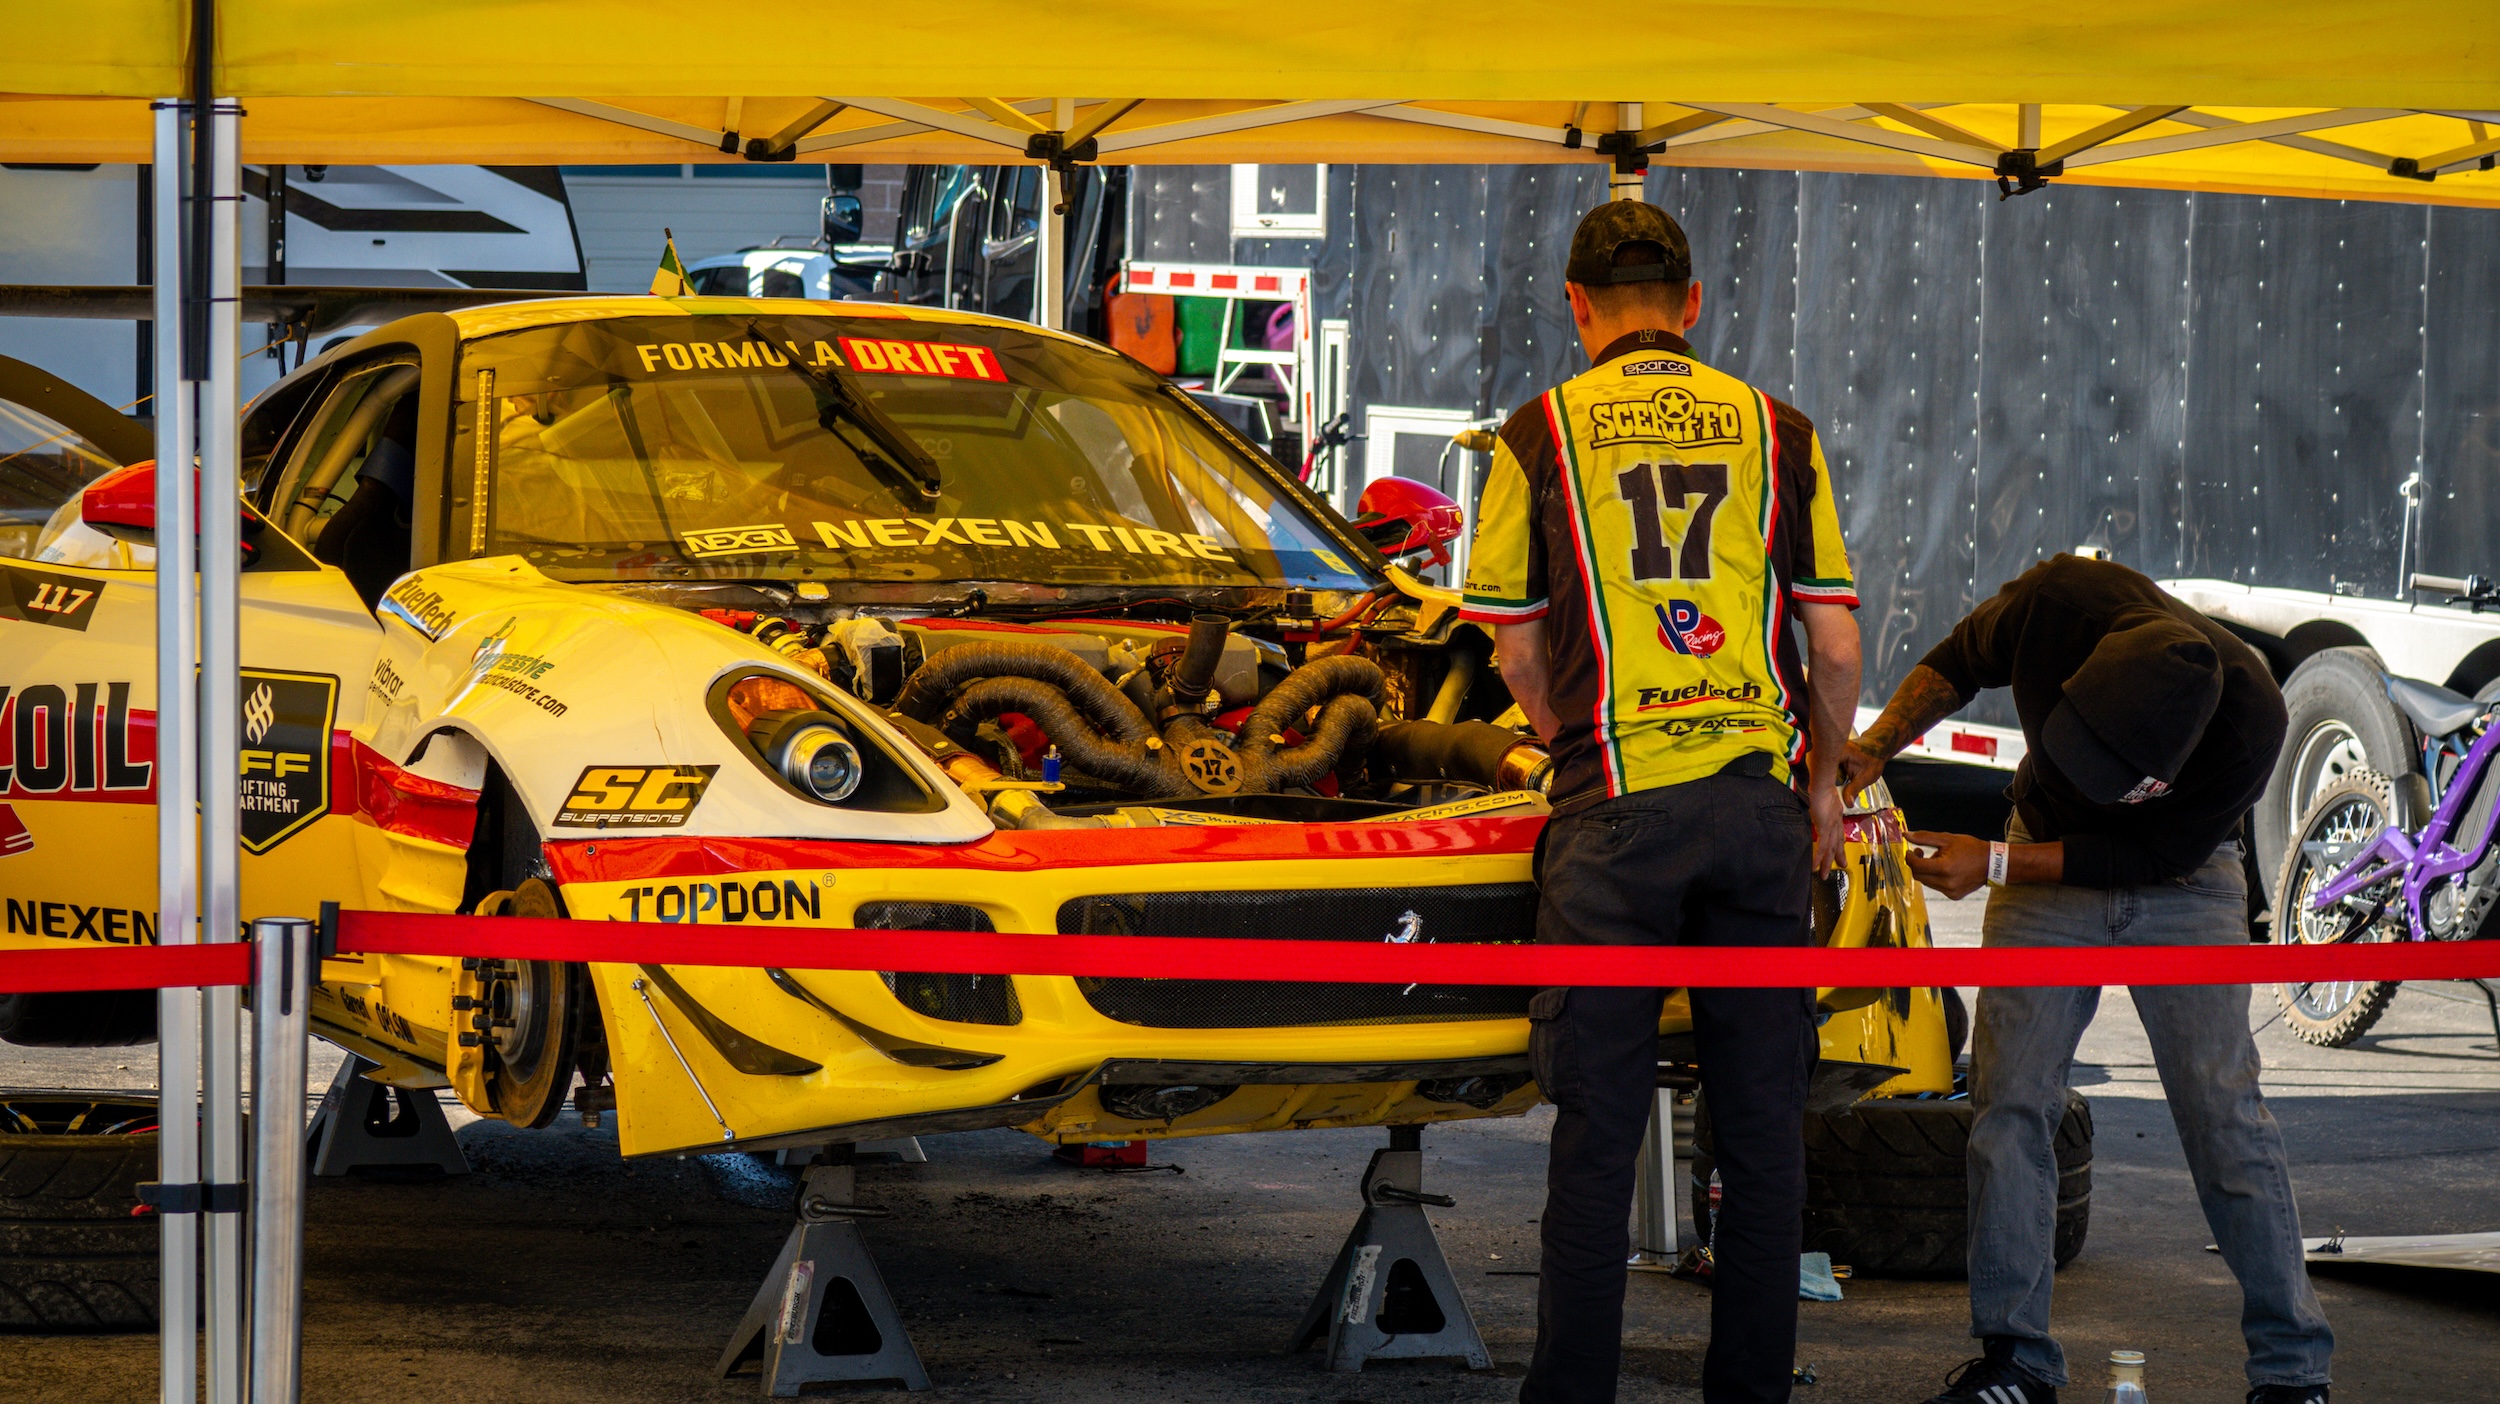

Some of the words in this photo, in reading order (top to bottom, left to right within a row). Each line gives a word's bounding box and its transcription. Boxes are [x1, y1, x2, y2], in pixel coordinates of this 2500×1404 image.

[850, 338, 990, 378] DRIFT
[1624, 361, 1690, 375] sparco
[1618, 463, 1728, 580] 17
[683, 527, 797, 553] NEXEN
[812, 517, 1061, 550] NEXEN
[1067, 522, 1236, 563] TIRE
[27, 583, 94, 615] 117
[1654, 599, 1699, 655] VP
[1683, 630, 1725, 650] Racing
[0, 681, 152, 794] OIL
[1700, 718, 1765, 731] AXCEL
[240, 749, 310, 778] FF
[1203, 760, 1222, 776] 17
[240, 794, 300, 814] ARTMENT
[558, 812, 684, 824] SUSPENSIONS
[6, 898, 158, 945] NEXEN
